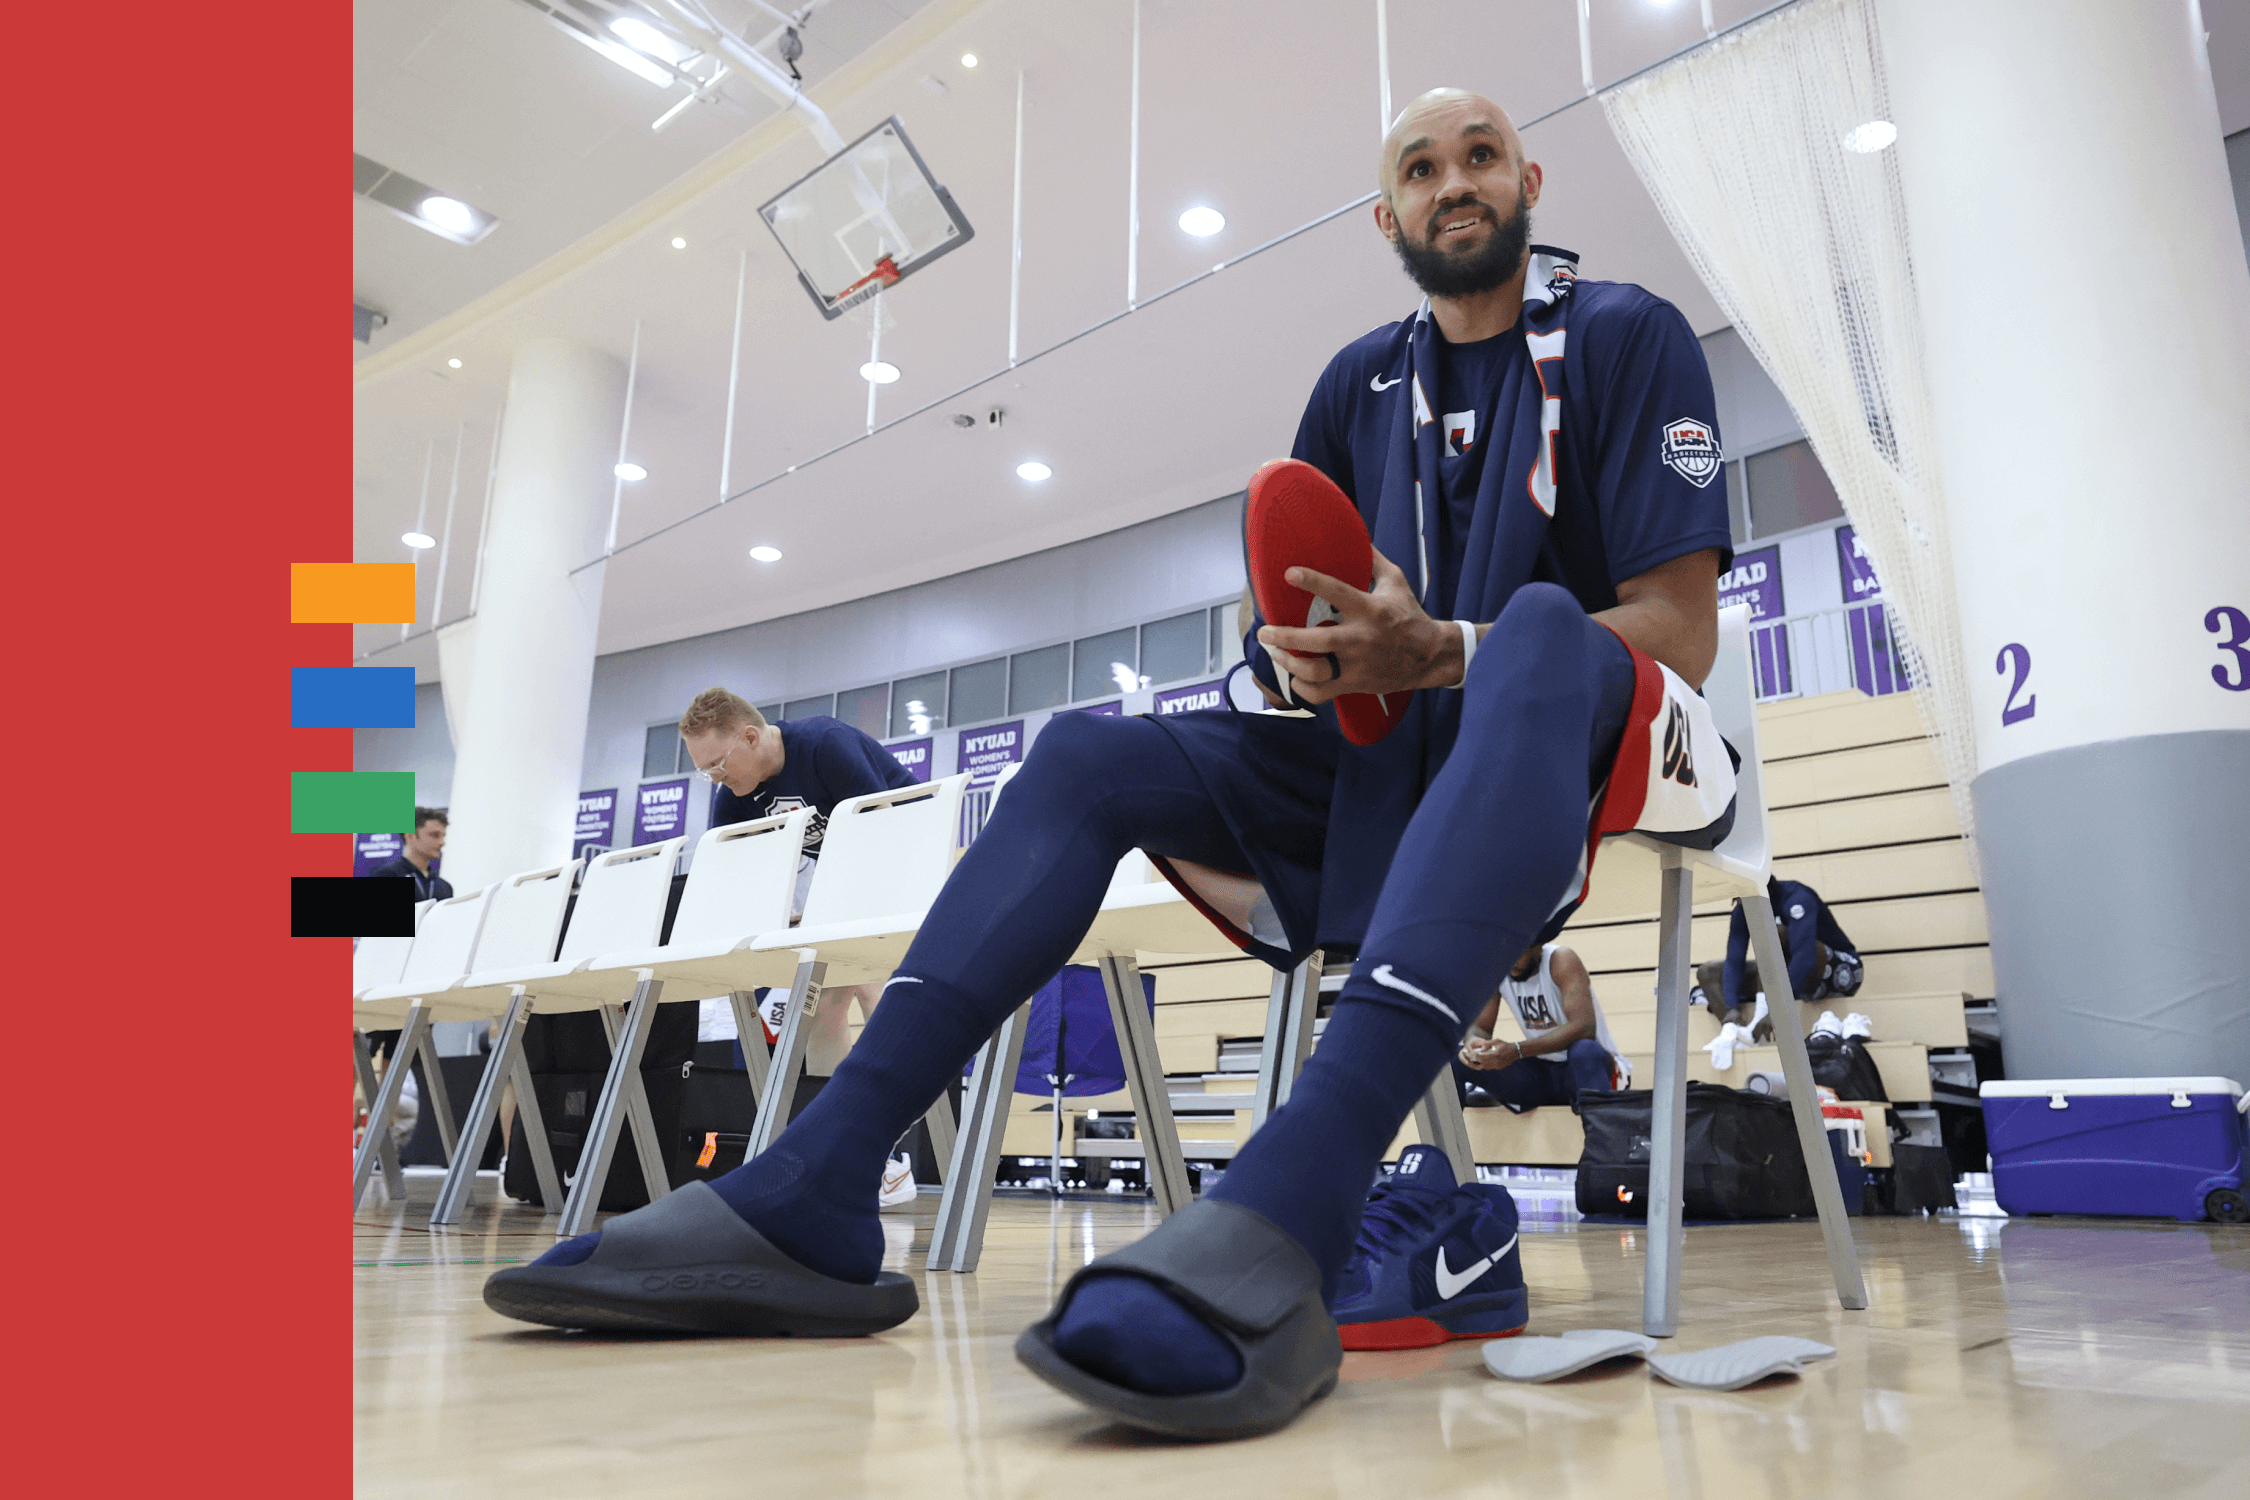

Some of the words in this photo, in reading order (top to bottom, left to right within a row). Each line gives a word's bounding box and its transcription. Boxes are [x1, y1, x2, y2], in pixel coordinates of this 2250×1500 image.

[1673, 430, 1709, 447] USA
[1667, 451, 1719, 460] BASKETBALL
[1718, 561, 1768, 592] UAD
[1718, 589, 1761, 610] MEN'S
[2204, 606, 2250, 692] 3
[1996, 643, 2036, 727] 2
[1161, 690, 1220, 715] NYUAD
[965, 730, 1017, 754] NYUAD
[893, 747, 926, 766] UAD
[969, 750, 1011, 766] WOMEN'S
[642, 786, 684, 805] NYUAD
[769, 1002, 787, 1027] USA
[1517, 994, 1554, 1024] USA
